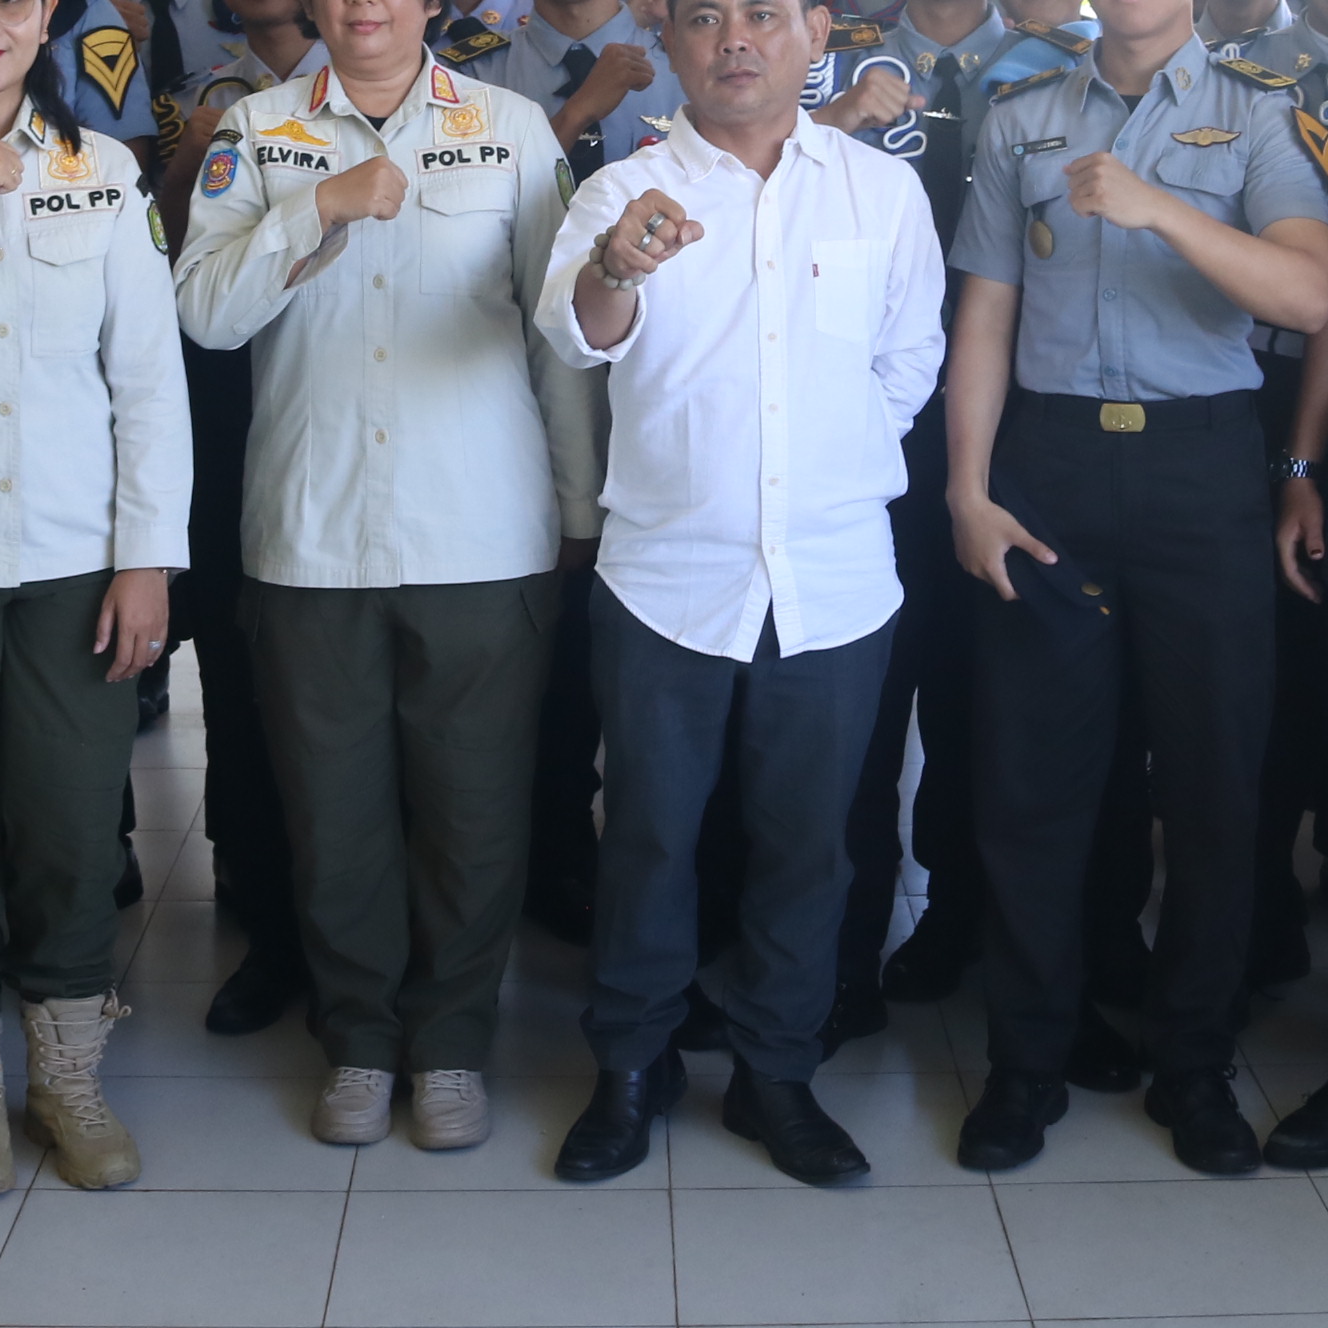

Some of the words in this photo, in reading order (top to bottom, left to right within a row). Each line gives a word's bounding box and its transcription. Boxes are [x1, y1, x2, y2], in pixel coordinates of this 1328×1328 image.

[256, 146, 330, 171] ELVIRA
[422, 149, 471, 169] POL
[479, 146, 510, 164] PP
[30, 193, 80, 215] POL
[88, 189, 121, 207] PP
